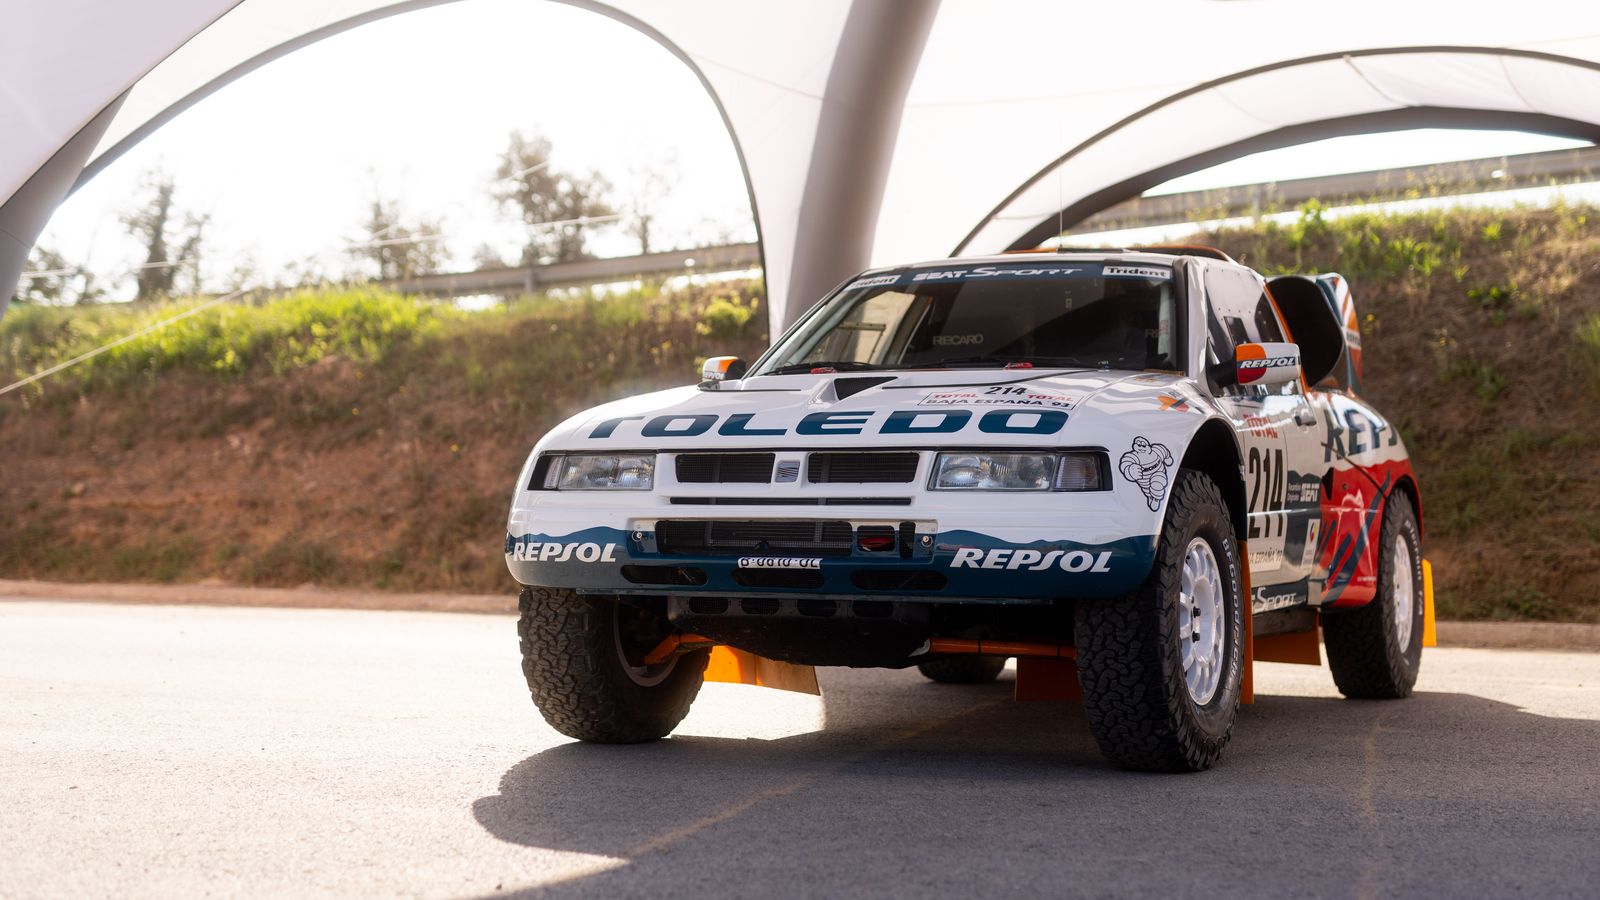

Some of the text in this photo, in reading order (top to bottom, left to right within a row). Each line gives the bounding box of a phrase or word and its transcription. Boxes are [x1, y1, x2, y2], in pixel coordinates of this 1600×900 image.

[912, 270, 967, 282] SEAT
[1107, 267, 1168, 278] Trident
[932, 334, 984, 346] RECARO
[1240, 357, 1295, 369] REPSOL
[984, 386, 1028, 396] 214
[1026, 394, 1074, 402] TOTAL
[587, 409, 1070, 440] TOLEDO
[1248, 446, 1284, 539] 214
[512, 541, 617, 563] REPSOL
[949, 547, 1113, 573] REPSOL
